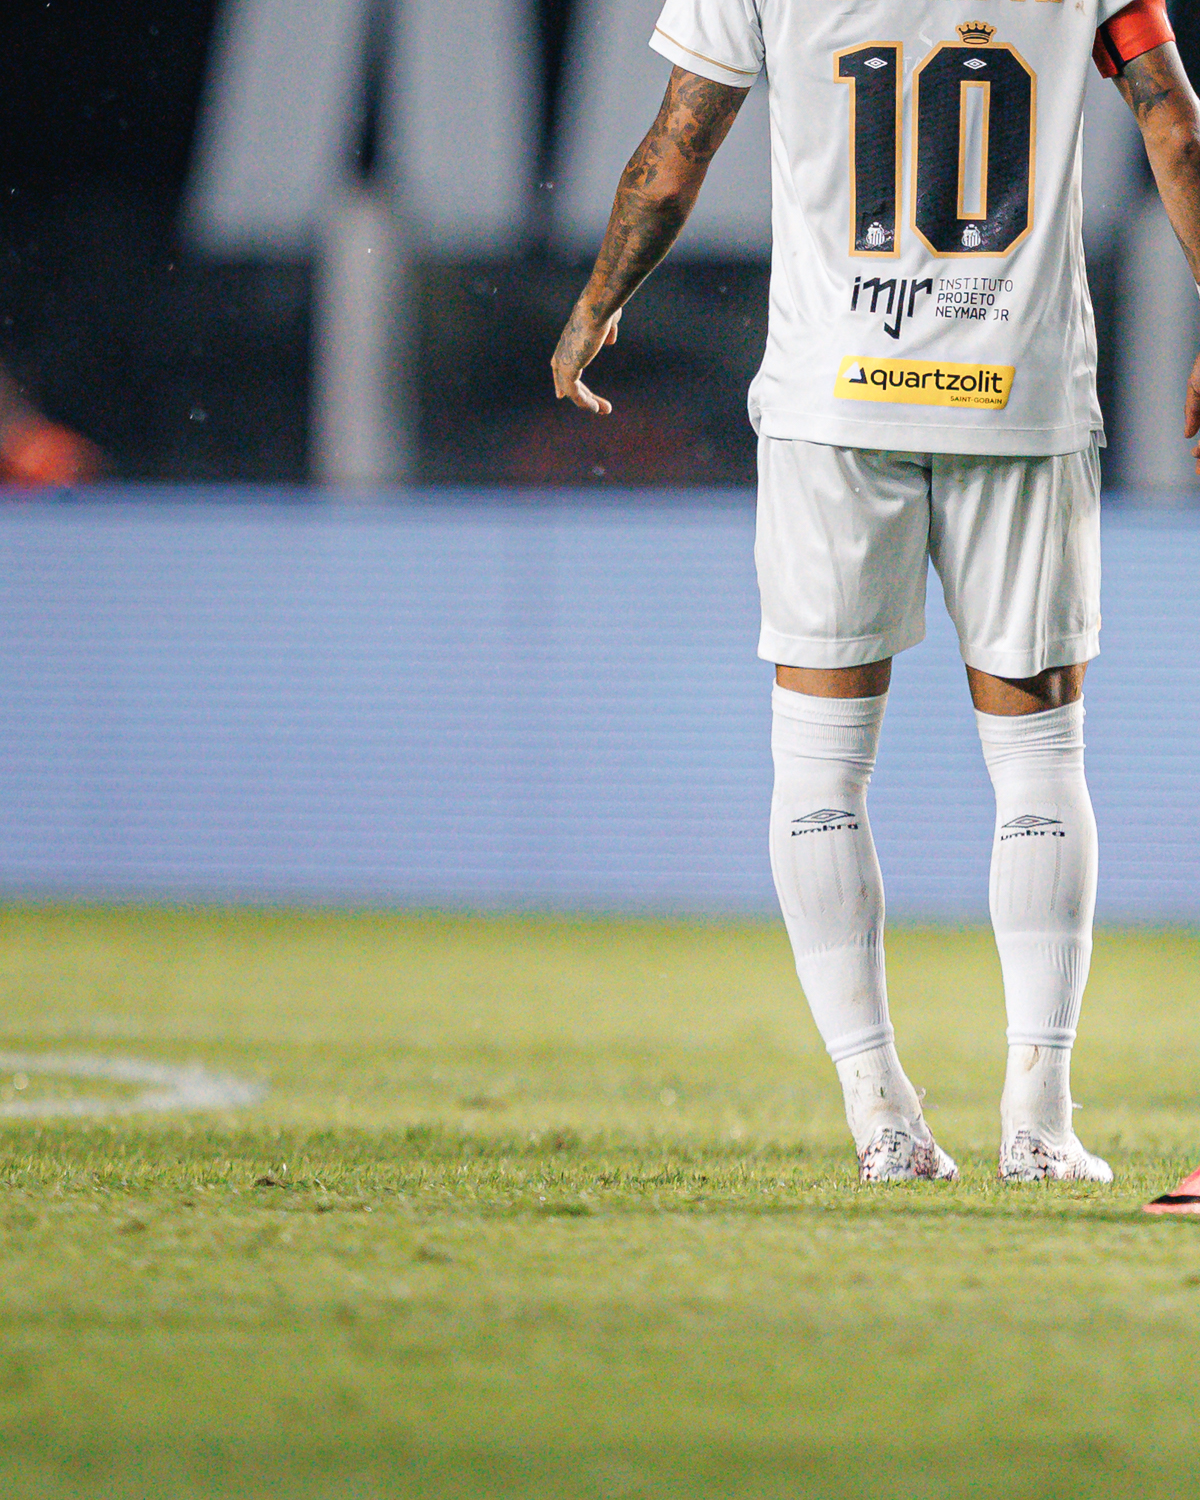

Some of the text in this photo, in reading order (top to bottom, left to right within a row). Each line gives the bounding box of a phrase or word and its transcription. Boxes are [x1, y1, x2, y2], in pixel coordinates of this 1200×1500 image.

[833, 40, 1037, 258] 10
[938, 277, 1014, 293] INSTITUTO
[937, 292, 995, 306] PROJETO
[935, 306, 1009, 322] NEYMAR JR
[869, 368, 1003, 394] quartzolit
[949, 395, 1003, 405] SAINT-GOBAIN
